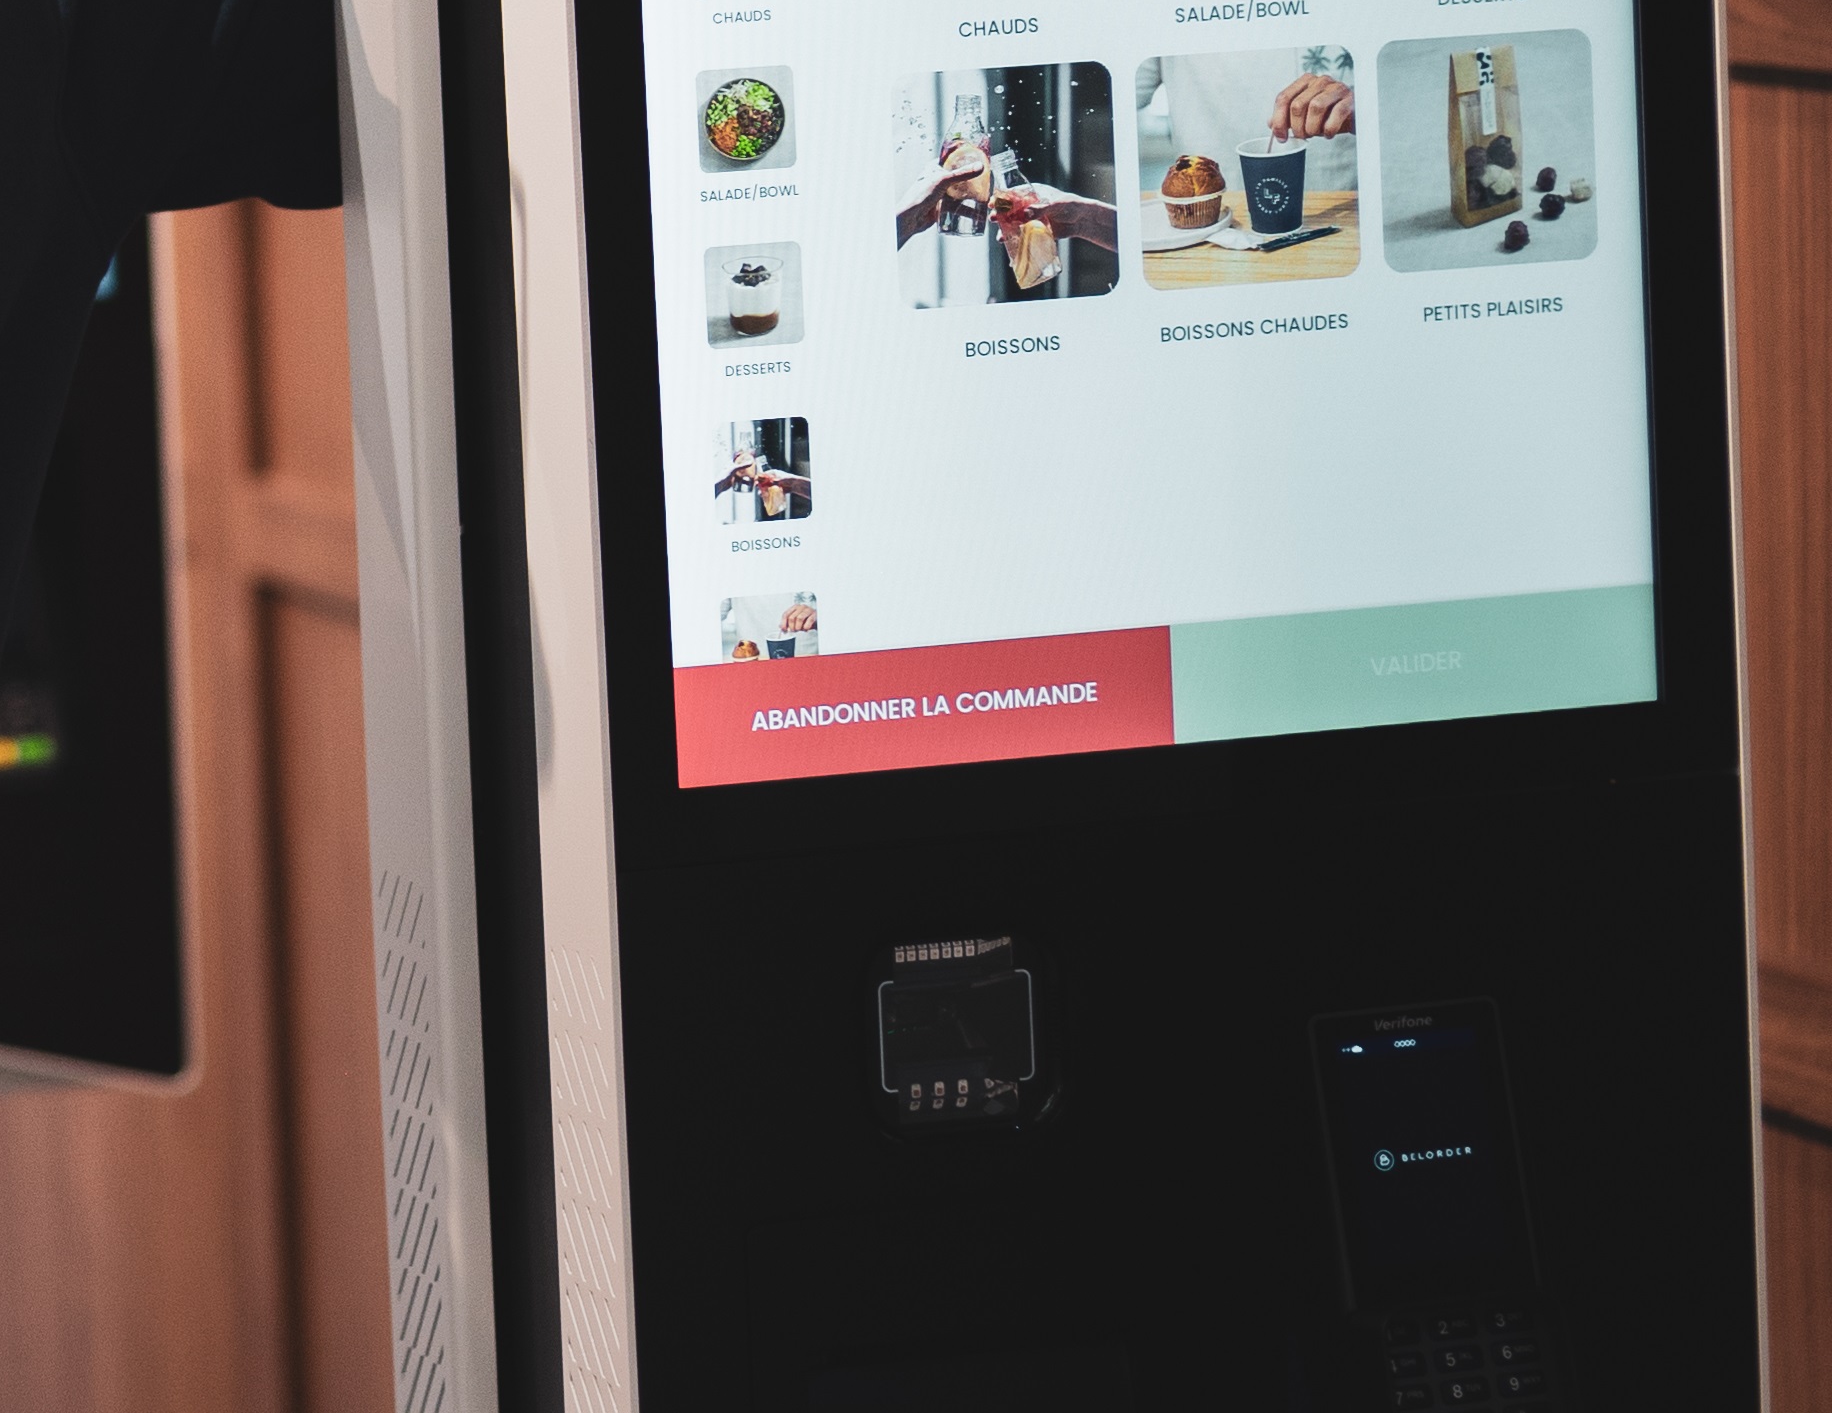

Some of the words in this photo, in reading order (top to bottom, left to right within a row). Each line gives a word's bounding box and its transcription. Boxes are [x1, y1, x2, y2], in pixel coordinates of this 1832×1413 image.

[713, 10, 771, 24] CHAUDS
[1176, 0, 1309, 23] SALADE/BOWL
[959, 18, 1038, 37] CHAUDS
[701, 184, 799, 202] SALADE/BOWL
[1424, 304, 1481, 322] PETITS
[1487, 297, 1562, 316] PLAISIRS
[1161, 321, 1254, 342] BOISSONS
[1261, 314, 1348, 334] CHAUDES
[966, 336, 1060, 357] BOISSONS
[726, 362, 791, 376] DESSERTS
[732, 536, 800, 552] BOISSONS
[1370, 651, 1461, 675] VALIDER
[752, 699, 915, 731] ABANDONNER
[923, 696, 950, 716] LA
[956, 682, 1097, 713] COMMANDE
[1374, 1015, 1433, 1031] Verifone
[1401, 1146, 1472, 1162] BELORDER
[1438, 1320, 1449, 1335] 2
[1495, 1313, 1506, 1327] 3
[1445, 1352, 1456, 1367] 5
[1502, 1345, 1513, 1359] 6
[1452, 1384, 1463, 1399] 8
[1509, 1377, 1520, 1391] 9
[1395, 1391, 1403, 1406] 7
